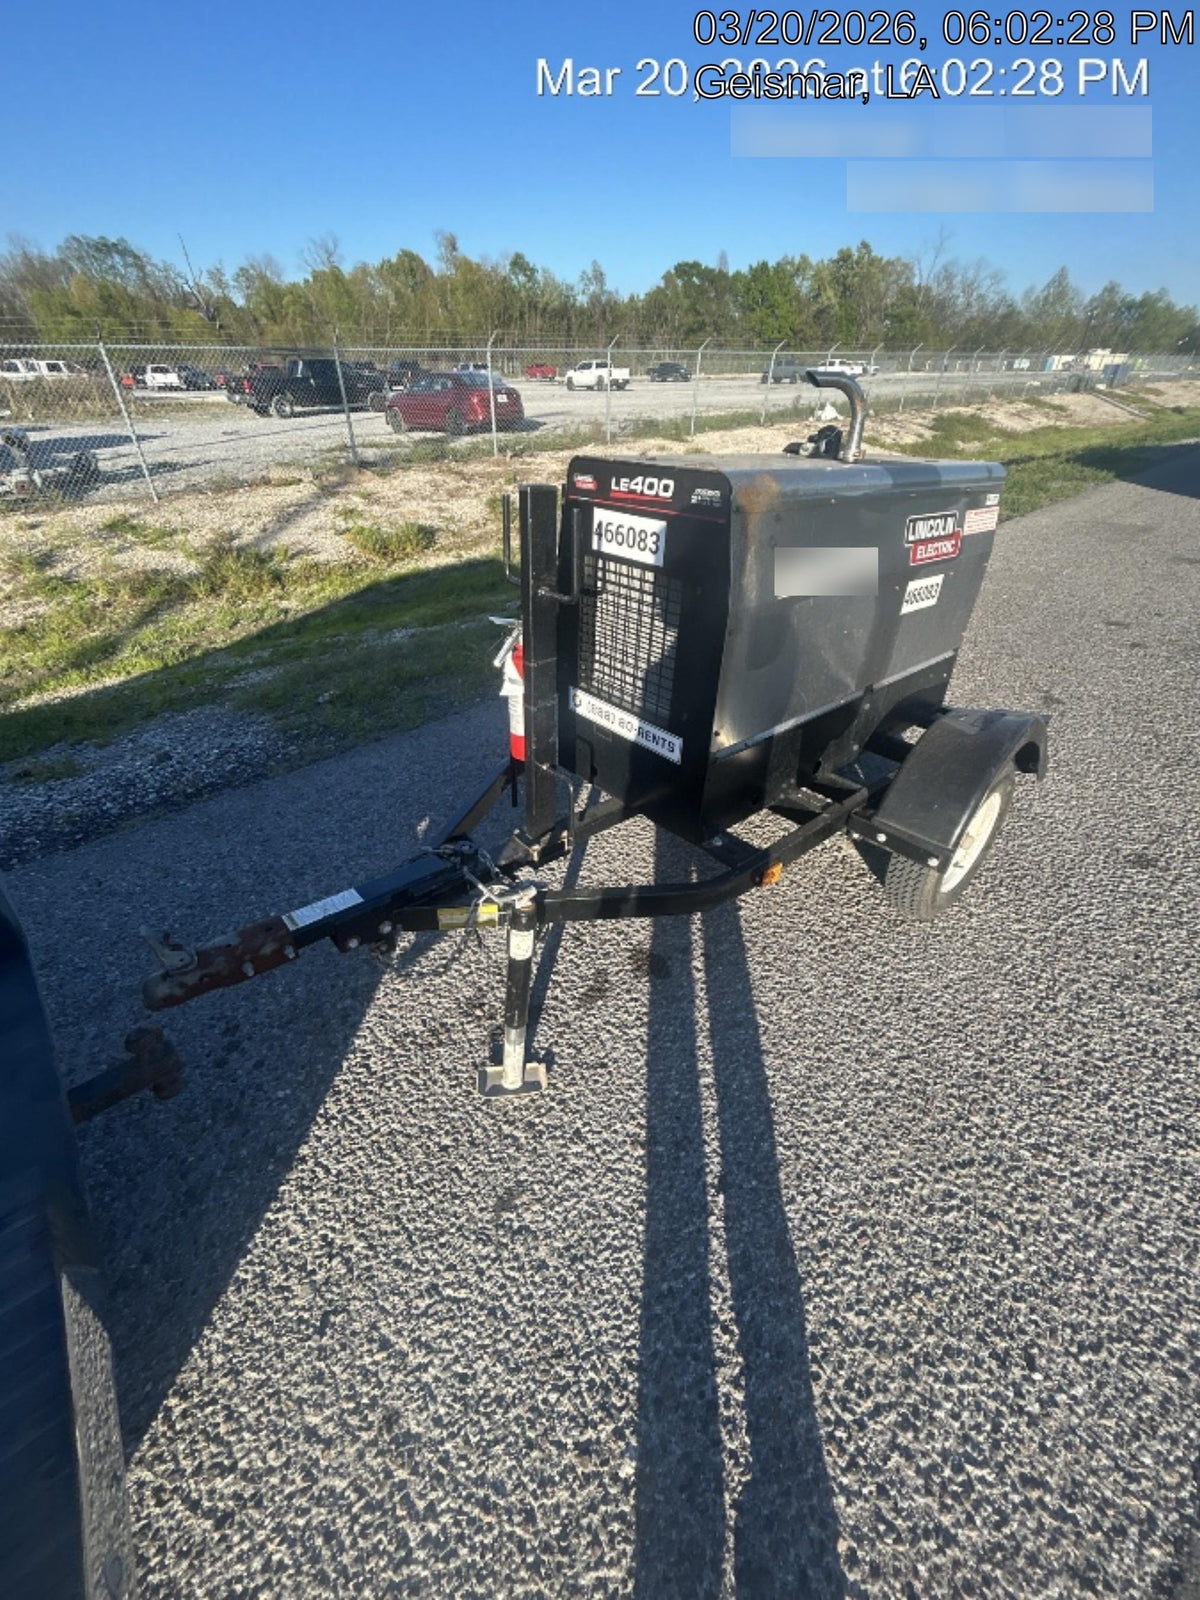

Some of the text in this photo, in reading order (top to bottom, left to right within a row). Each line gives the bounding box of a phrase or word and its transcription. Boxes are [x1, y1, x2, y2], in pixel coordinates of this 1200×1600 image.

[610, 475, 675, 498] LE400
[594, 520, 661, 556] 466083
[908, 516, 958, 542] LINCOLN
[916, 540, 956, 559] ELECTRIC
